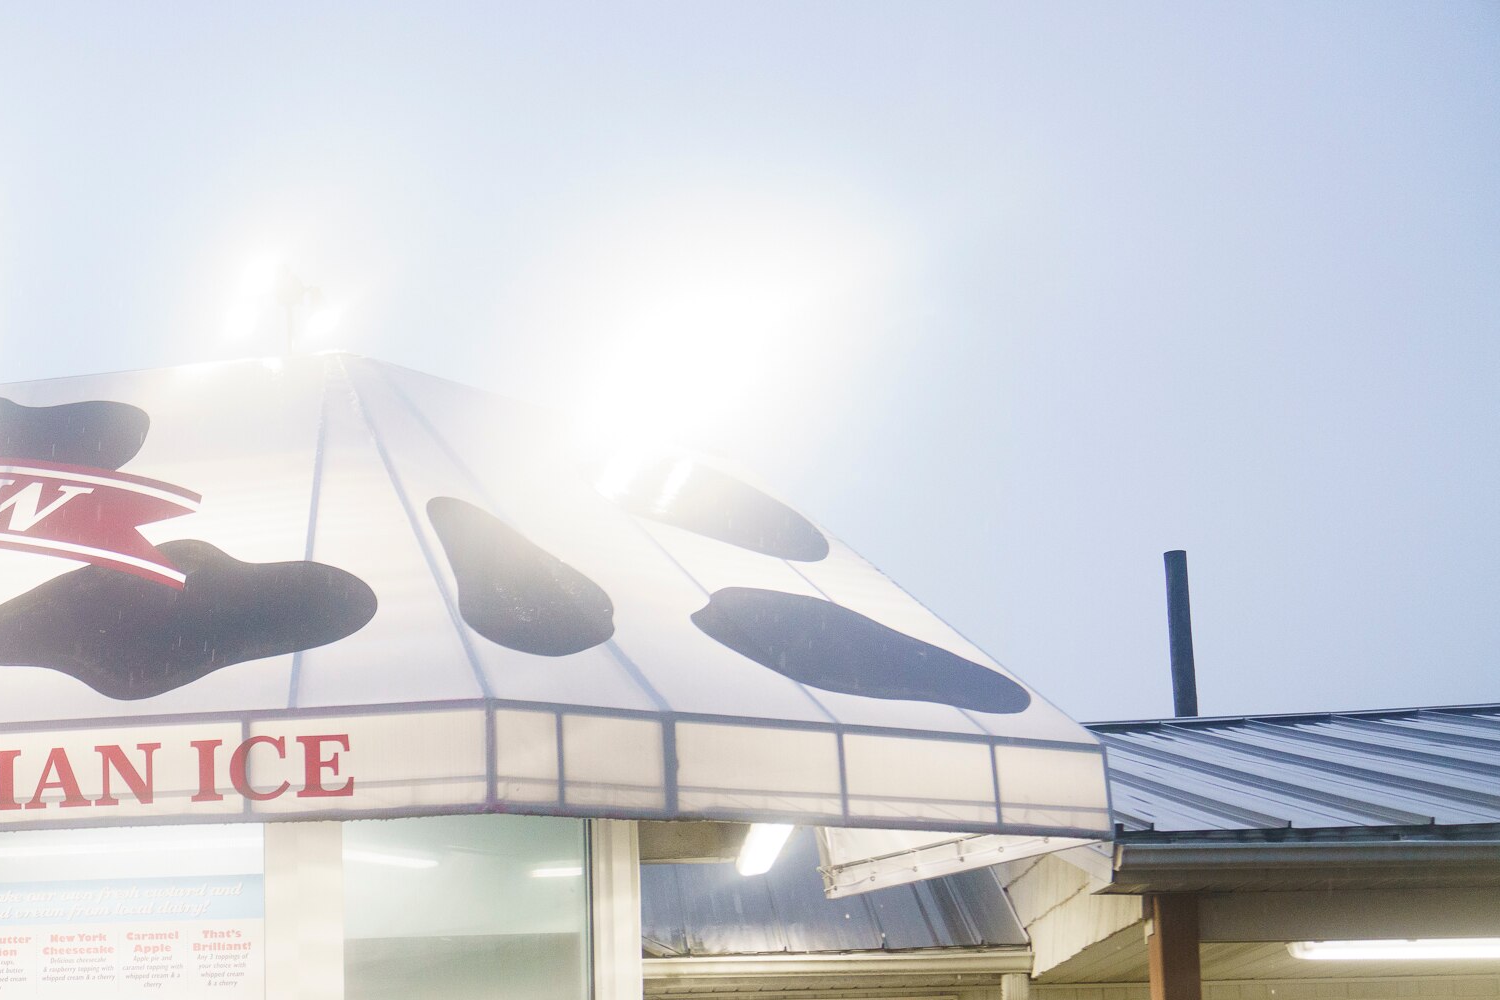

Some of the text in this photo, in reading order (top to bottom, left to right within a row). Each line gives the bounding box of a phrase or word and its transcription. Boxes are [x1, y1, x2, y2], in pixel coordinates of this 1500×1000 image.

[190, 734, 355, 802] ICE
[26, 892, 54, 902] our
[59, 891, 95, 902] own
[99, 885, 141, 904] fresh
[146, 883, 209, 898] custard
[211, 882, 245, 897] and
[15, 909, 64, 919] cream
[67, 903, 112, 920] from
[116, 902, 157, 915] local
[158, 900, 212, 918] dairy!
[50, 933, 108, 943] New York
[126, 930, 180, 941] Caramel
[202, 929, 242, 939] That's
[42, 945, 116, 955] Cheesecake
[133, 944, 172, 954] Apple
[192, 941, 252, 951] Brilliant!
[150, 955, 161, 963] pie
[197, 953, 208, 961] Any
[215, 953, 241, 962] toppings
[49, 966, 76, 974] raspberry
[77, 966, 100, 974] topping
[146, 964, 169, 972] topping
[42, 974, 66, 983] whipped
[97, 974, 116, 982] cherry
[125, 972, 150, 981] whipped
[200, 970, 225, 979] whipped
[143, 981, 163, 989] cherry
[218, 979, 238, 988] cherry
